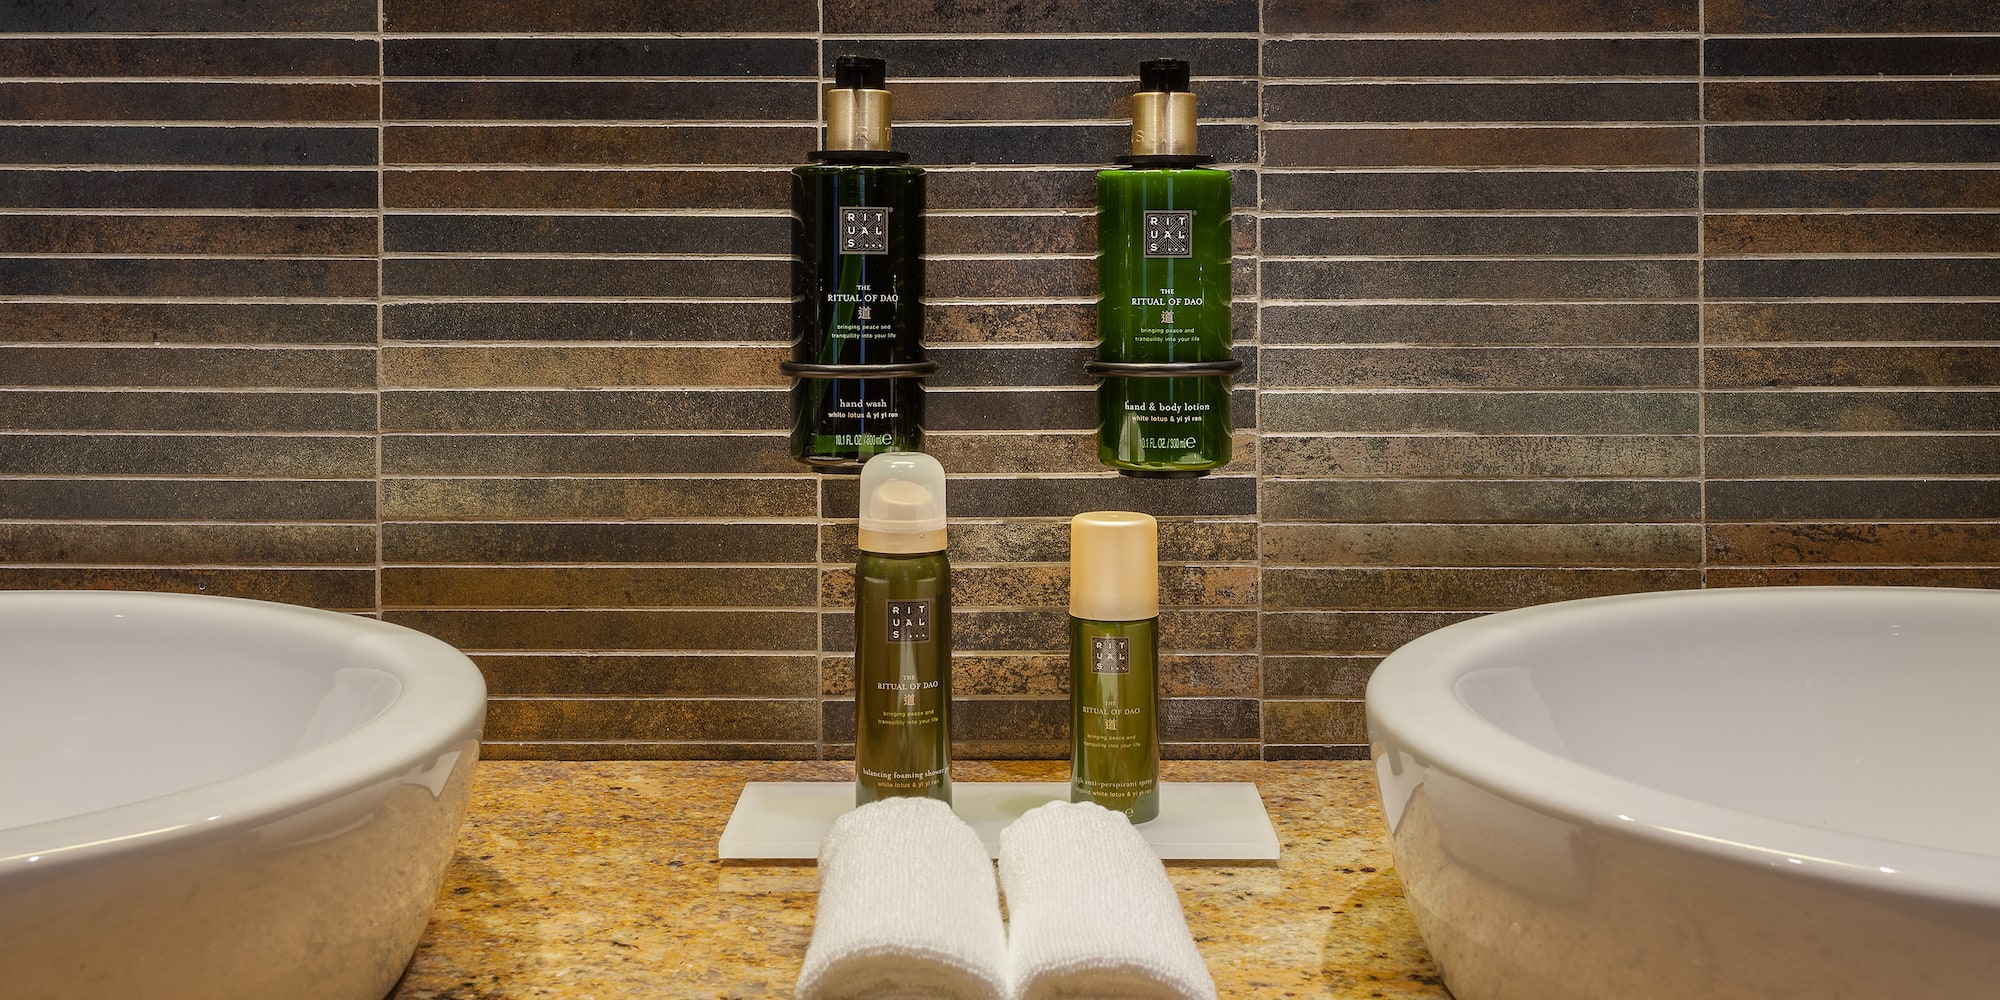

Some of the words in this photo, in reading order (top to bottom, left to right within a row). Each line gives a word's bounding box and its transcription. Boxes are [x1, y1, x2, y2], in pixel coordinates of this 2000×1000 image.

[827, 294, 862, 302] RITUAL
[864, 294, 878, 302] OF
[880, 294, 899, 302] DAO
[840, 399, 863, 408] hand
[866, 399, 887, 408] wash
[1124, 401, 1146, 410] hand
[1149, 402, 1156, 411] &
[1159, 403, 1182, 414] body
[1184, 403, 1210, 411] lotion
[877, 682, 908, 690] RITUAL
[909, 682, 922, 690] OF
[923, 680, 939, 689] DAO
[1082, 706, 1109, 715] RITUAL
[1124, 707, 1141, 715] DAO
[862, 767, 892, 780] balancing
[893, 772, 924, 780] foaming
[925, 768, 944, 777] shower
[1084, 780, 1137, 789] anti-perspirant
